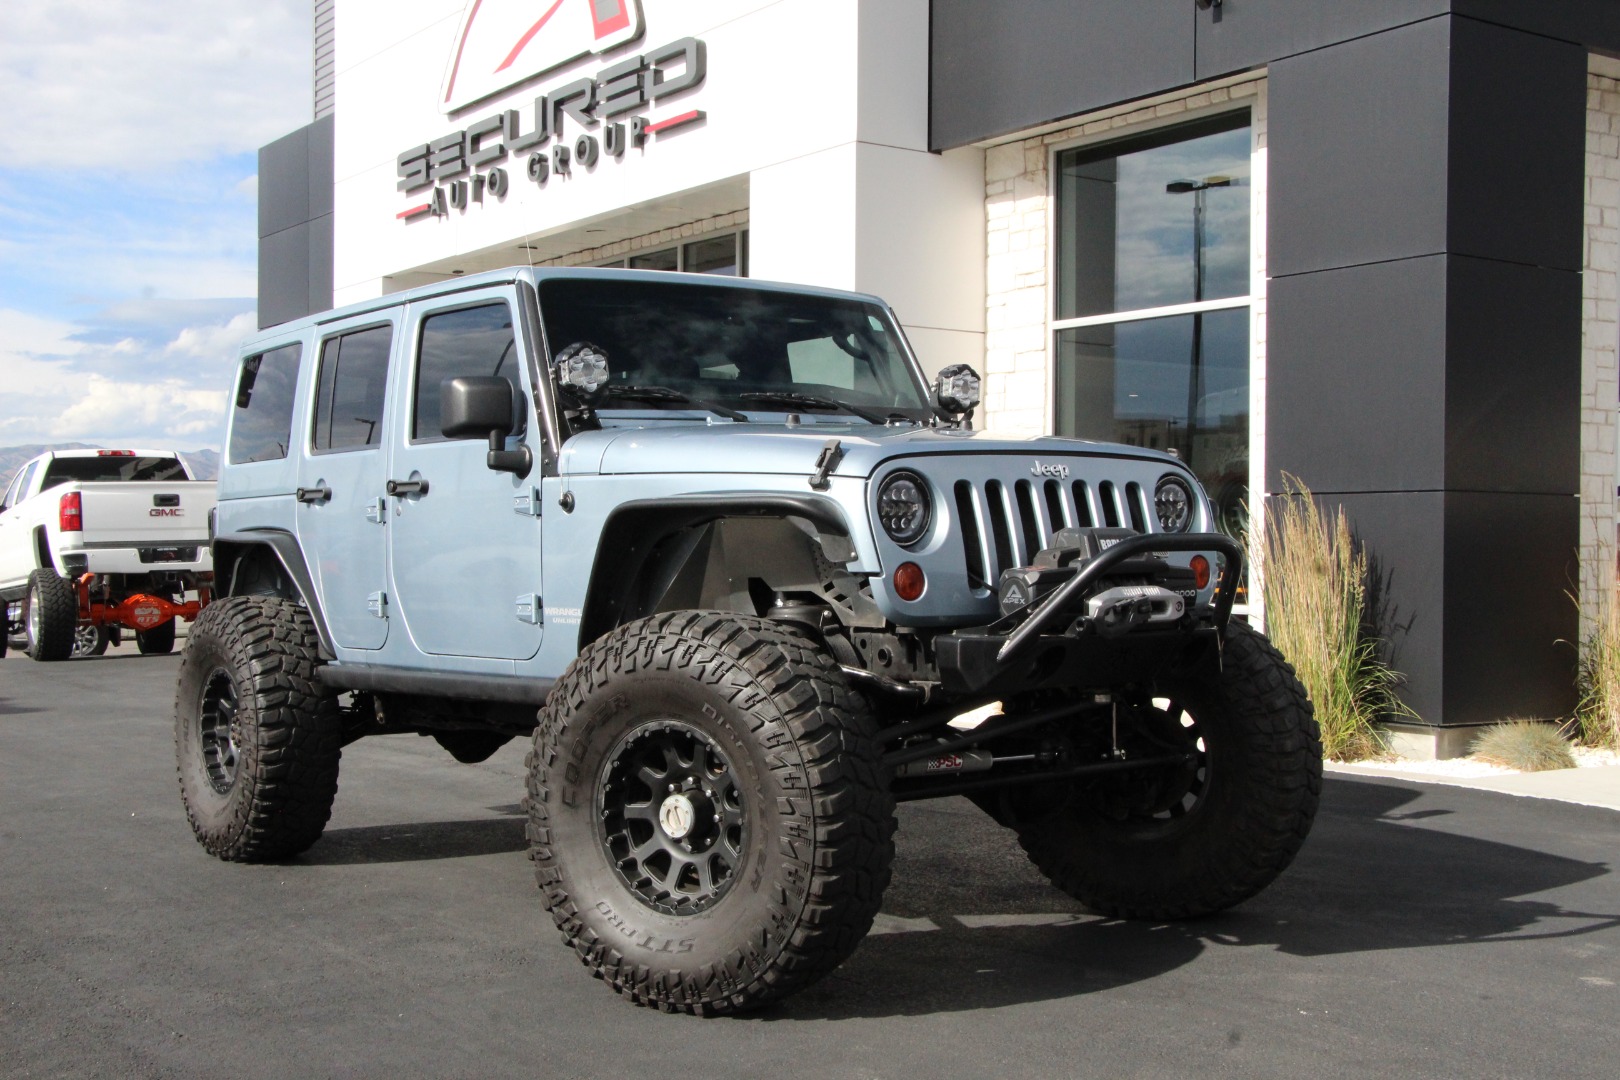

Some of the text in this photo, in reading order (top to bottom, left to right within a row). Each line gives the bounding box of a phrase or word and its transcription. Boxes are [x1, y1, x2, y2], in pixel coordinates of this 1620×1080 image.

[397, 36, 706, 193] SECURED
[430, 116, 650, 218] AUTO GROUP
[1030, 459, 1070, 480] Jeep
[149, 508, 185, 517] GMC
[1002, 597, 1026, 605] APEX
[544, 607, 583, 617] WRANGL
[552, 617, 581, 625] UNLIMIT
[936, 754, 962, 768] PSC
[595, 901, 638, 937] PRO
[636, 935, 696, 954] STT
